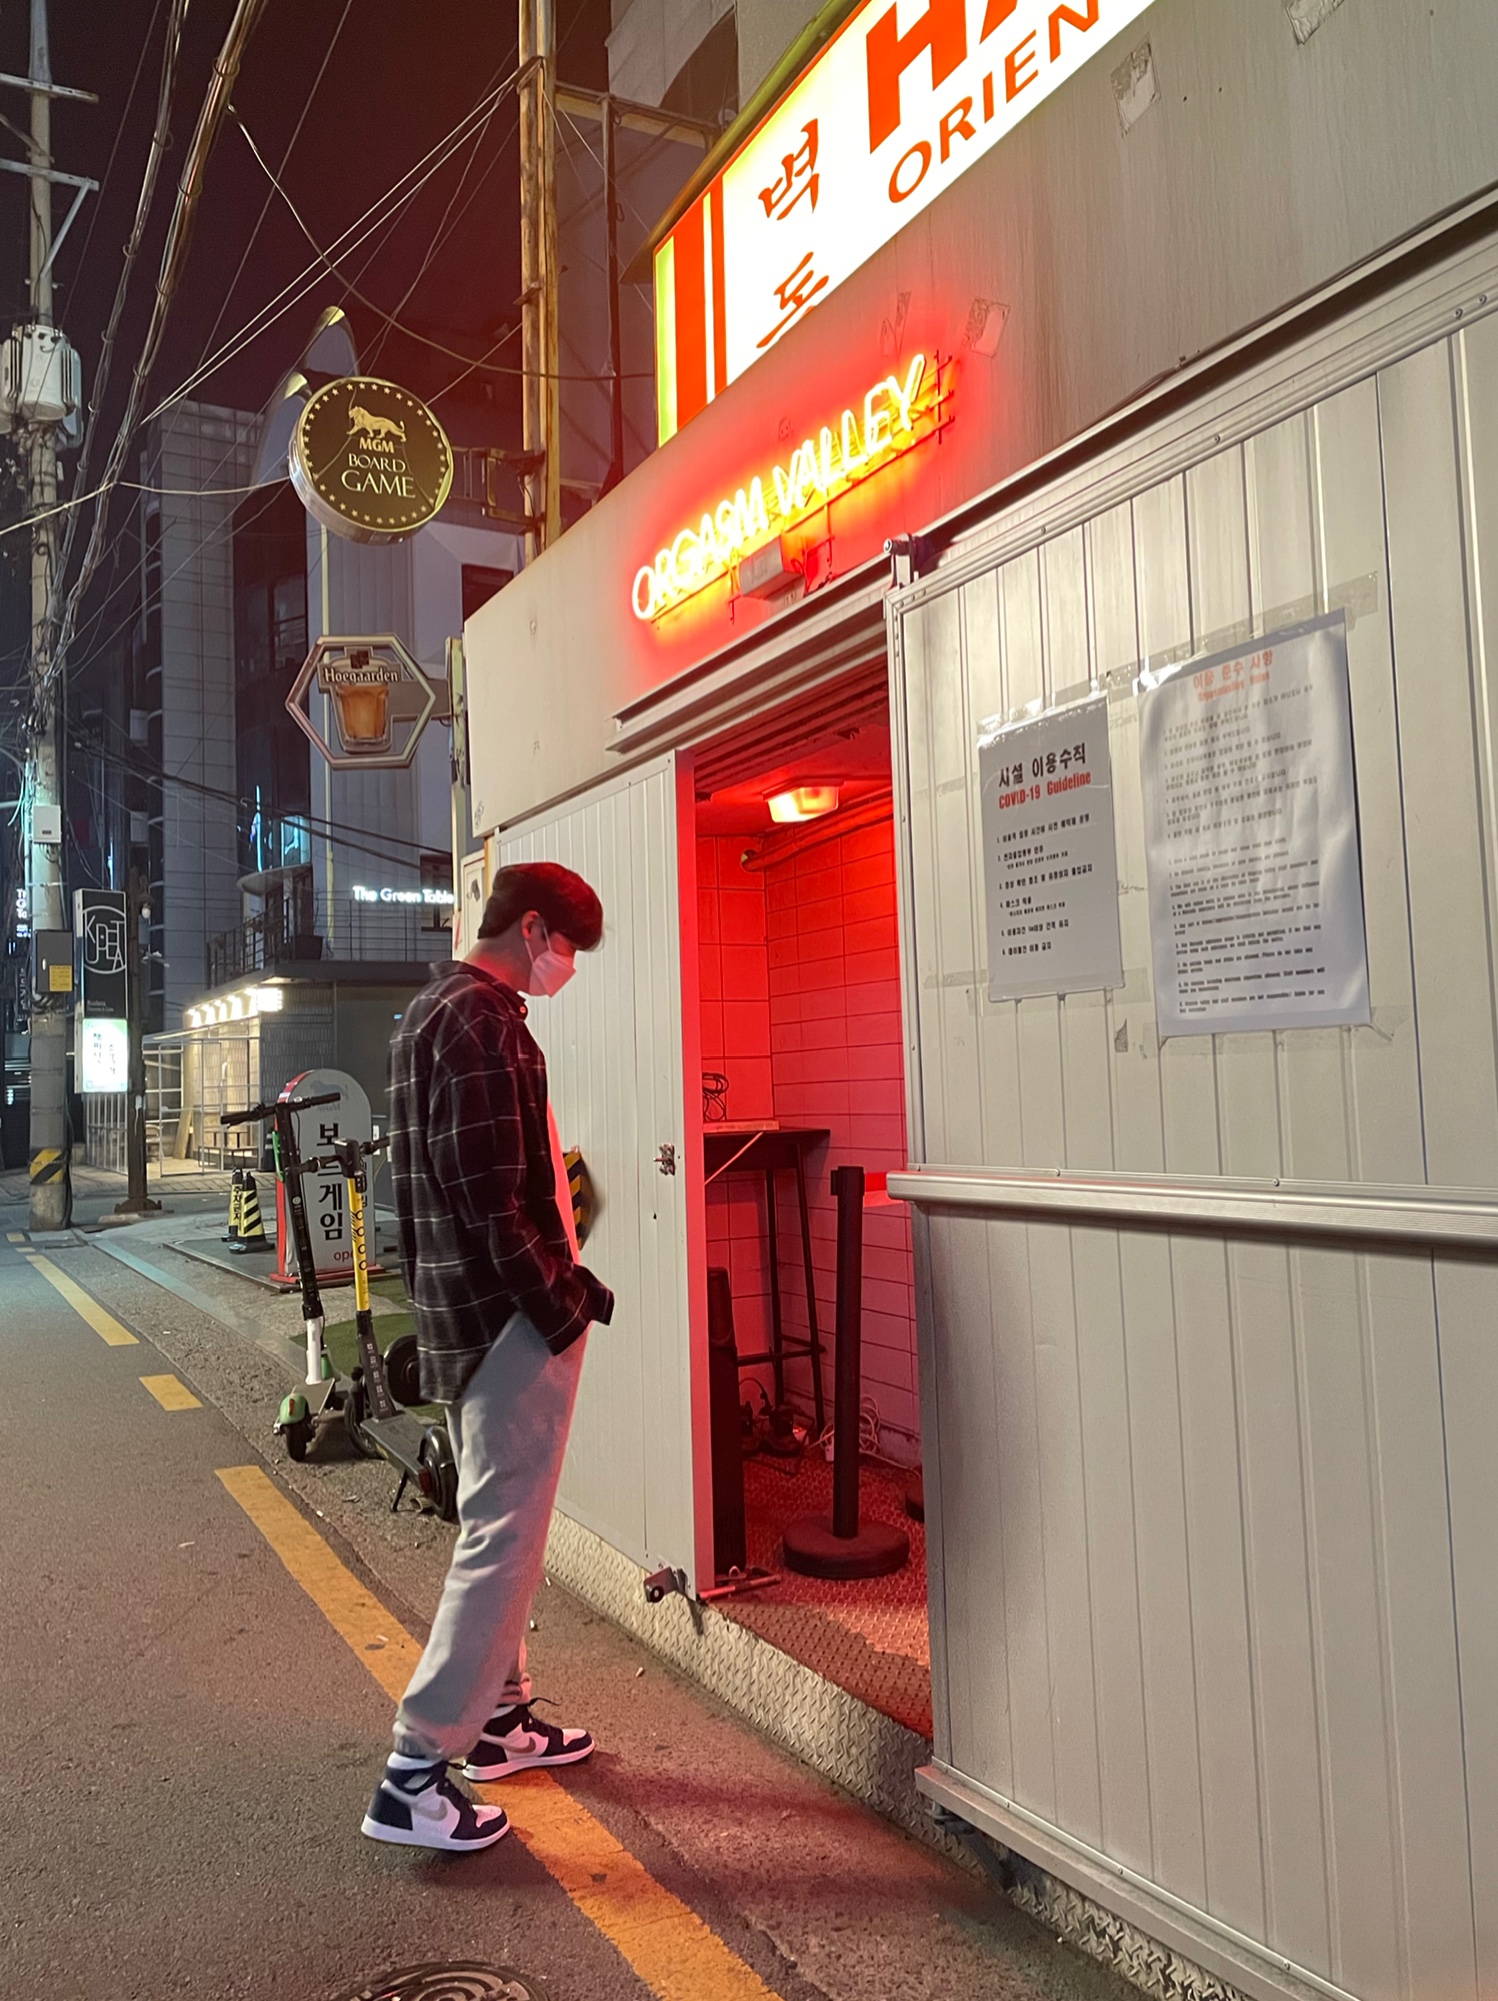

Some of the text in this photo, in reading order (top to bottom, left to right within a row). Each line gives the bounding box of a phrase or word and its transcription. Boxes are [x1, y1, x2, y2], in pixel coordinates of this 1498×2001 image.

[866, 0, 1019, 154] H
[360, 437, 394, 454] MGM
[348, 453, 406, 473] BOARD
[341, 469, 416, 498] GAME
[632, 352, 927, 620] ORGASM VALLEY
[323, 667, 400, 686] Hoegaarden
[998, 762, 1024, 788] 시설
[998, 771, 1092, 809] COVID-19 Guideline
[352, 885, 378, 902] The
[380, 888, 421, 903] Green
